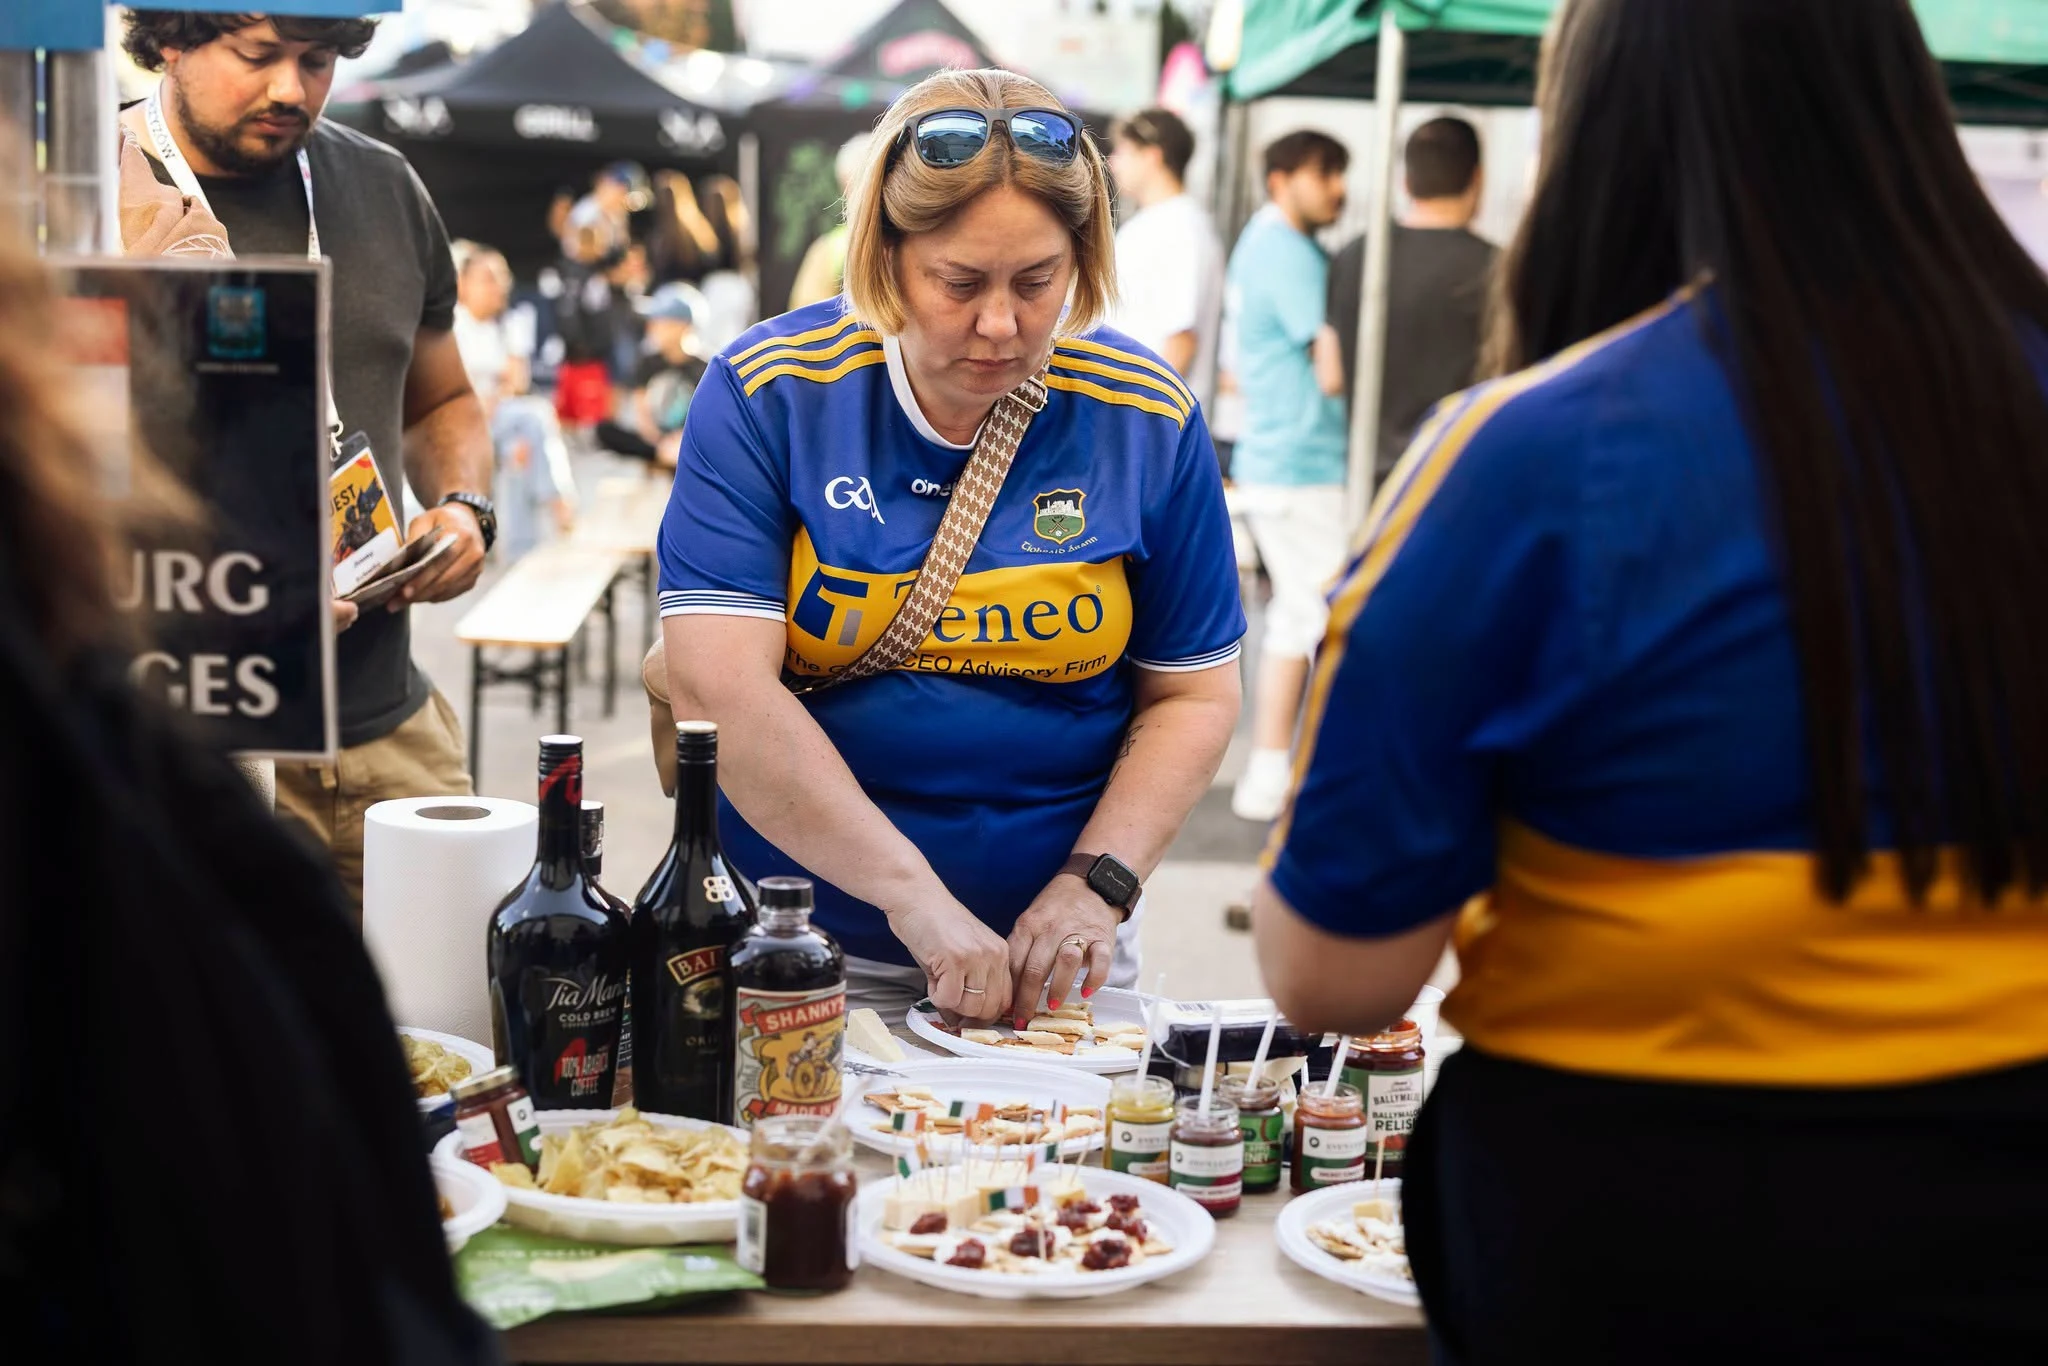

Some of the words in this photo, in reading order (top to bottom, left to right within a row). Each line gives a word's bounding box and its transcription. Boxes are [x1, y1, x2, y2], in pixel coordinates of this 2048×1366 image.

[894, 579, 1104, 643] eneo
[902, 653, 953, 672] CEO
[1064, 654, 1108, 676] Firm
[543, 977, 583, 1011] Tia
[559, 1012, 591, 1023] COLD
